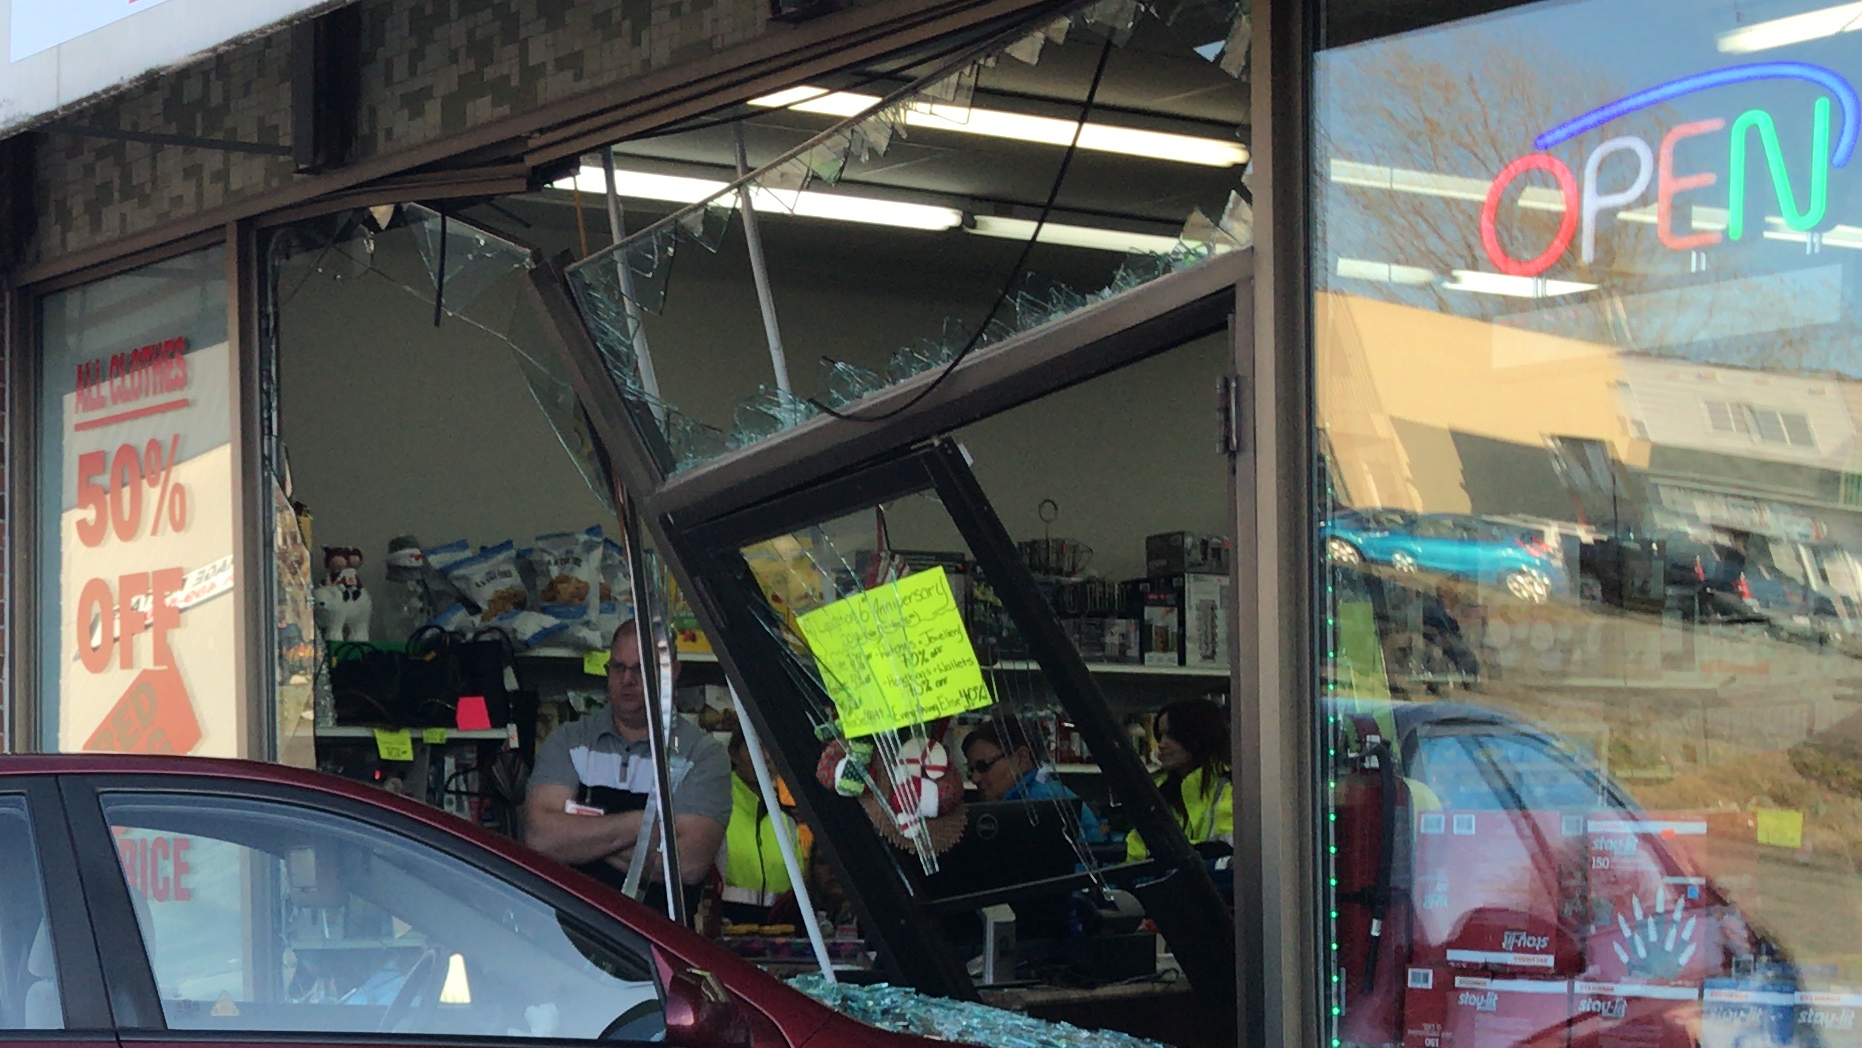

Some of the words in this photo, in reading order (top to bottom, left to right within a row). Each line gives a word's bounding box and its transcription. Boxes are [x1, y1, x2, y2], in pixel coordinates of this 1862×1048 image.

[1480, 96, 1830, 278] OPEN
[75, 359, 107, 414] ALL
[109, 336, 187, 406] CLOTHES
[75, 433, 187, 548] 50%
[77, 567, 183, 674] OFF
[119, 837, 191, 902] RICE
